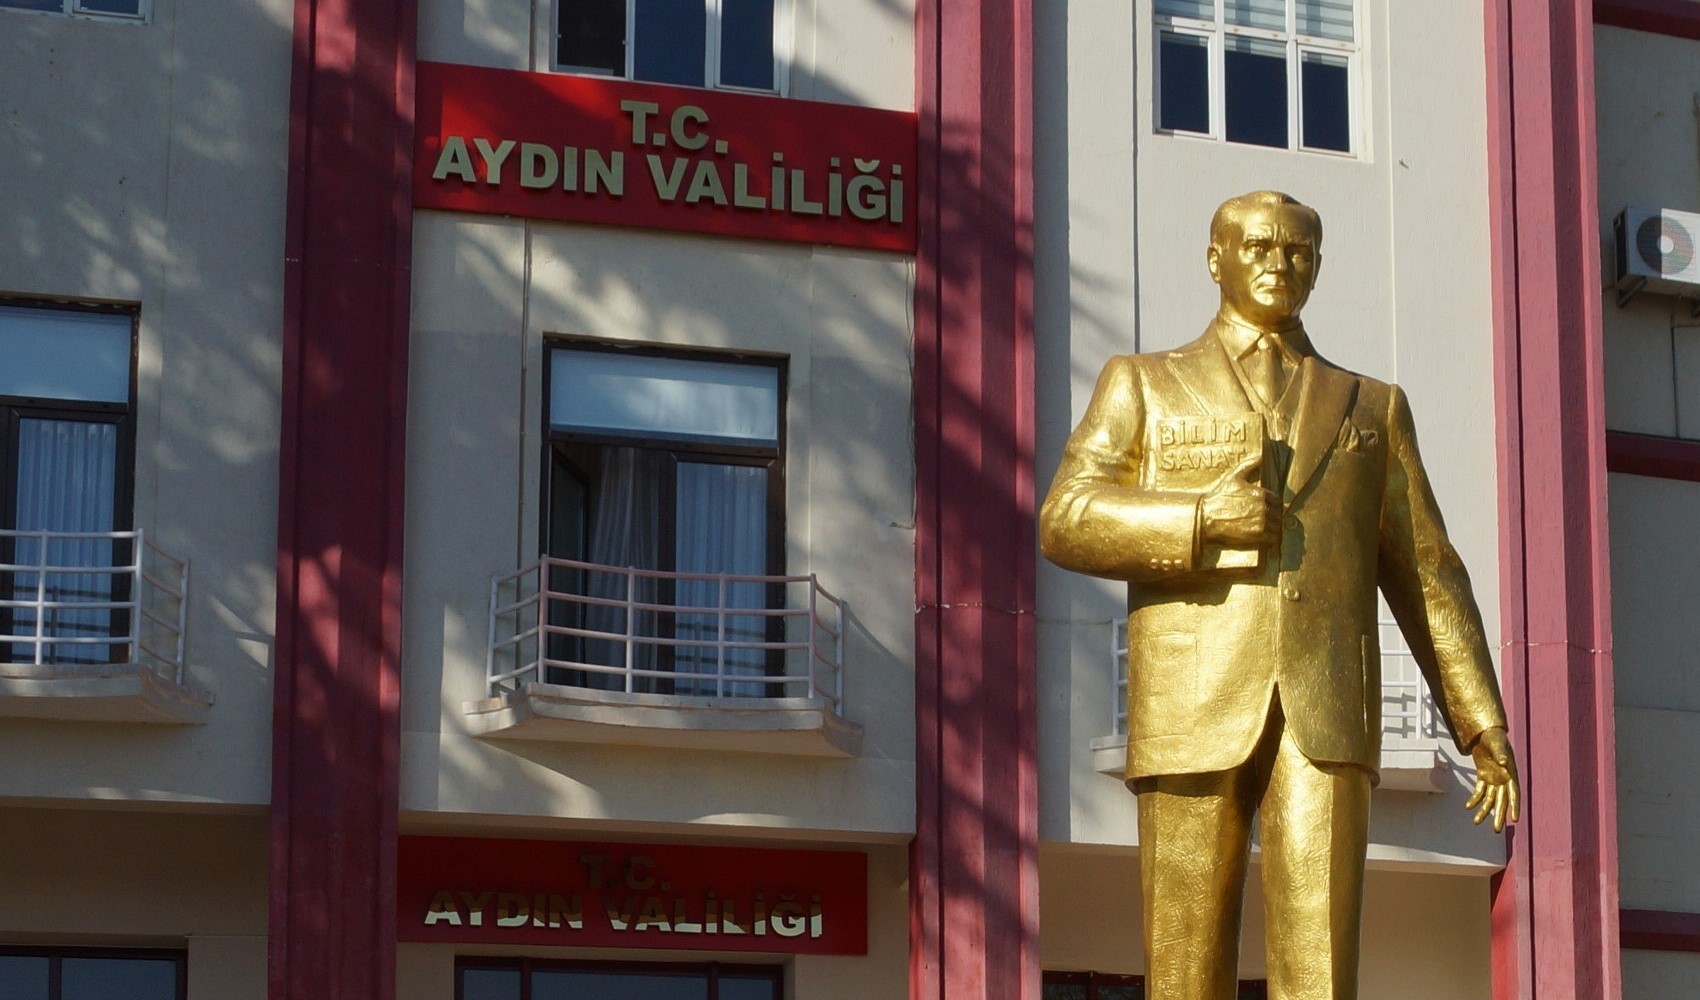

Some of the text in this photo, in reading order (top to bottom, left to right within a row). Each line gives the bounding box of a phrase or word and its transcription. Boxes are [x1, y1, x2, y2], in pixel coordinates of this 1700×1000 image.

[620, 99, 729, 155] T.C.
[432, 135, 905, 224] AYDIN VALİLİĞİ
[1160, 418, 1247, 446] BİLİM
[1160, 448, 1248, 472] SANAT
[579, 853, 672, 891] T.C.
[423, 889, 823, 939] AYDIN VALİLİĞİ
